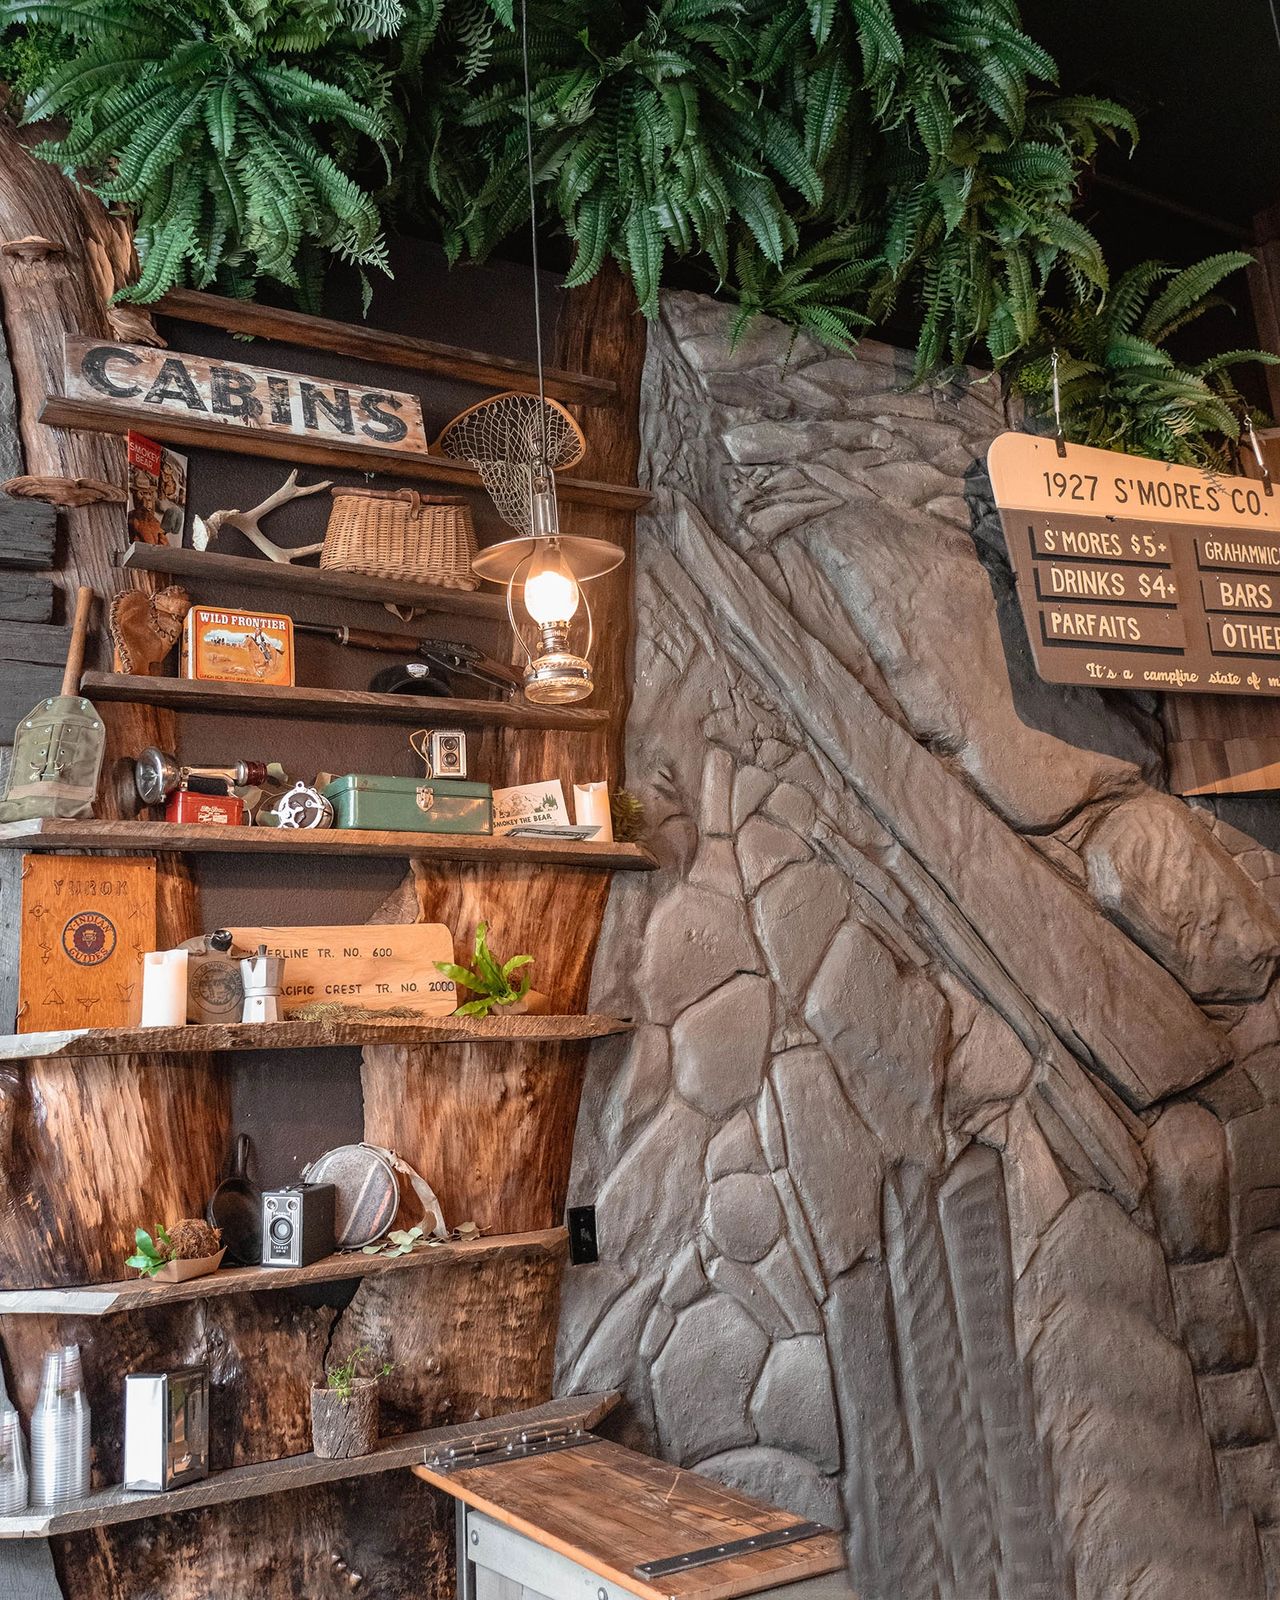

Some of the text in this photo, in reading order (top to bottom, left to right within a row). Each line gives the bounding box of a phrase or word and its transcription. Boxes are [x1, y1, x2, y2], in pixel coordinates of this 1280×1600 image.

[81, 346, 408, 443] CABINS
[130, 441, 160, 463] SMOKEY
[135, 453, 154, 470] BEAR
[1043, 471, 1269, 516] 1927 S'MORES CO.
[1044, 529, 1168, 558] S'MORES $5+
[1204, 541, 1280, 566] GRAHAMWIC
[1051, 567, 1176, 599] DRINKS $4+
[1219, 582, 1273, 609] BARS
[199, 612, 286, 630] WILD FRONTIER
[1051, 611, 1141, 640] PARFAITS
[1086, 662, 1280, 690] It's a campfire state of m
[493, 813, 552, 828] SMOKEY THE BEAR
[69, 947, 108, 962] GUIDES
[318, 949, 335, 958] TR.
[343, 948, 362, 958] NO.
[372, 948, 393, 957] 600
[279, 981, 455, 996] ACIFIC CREST TR. NO. 2000
